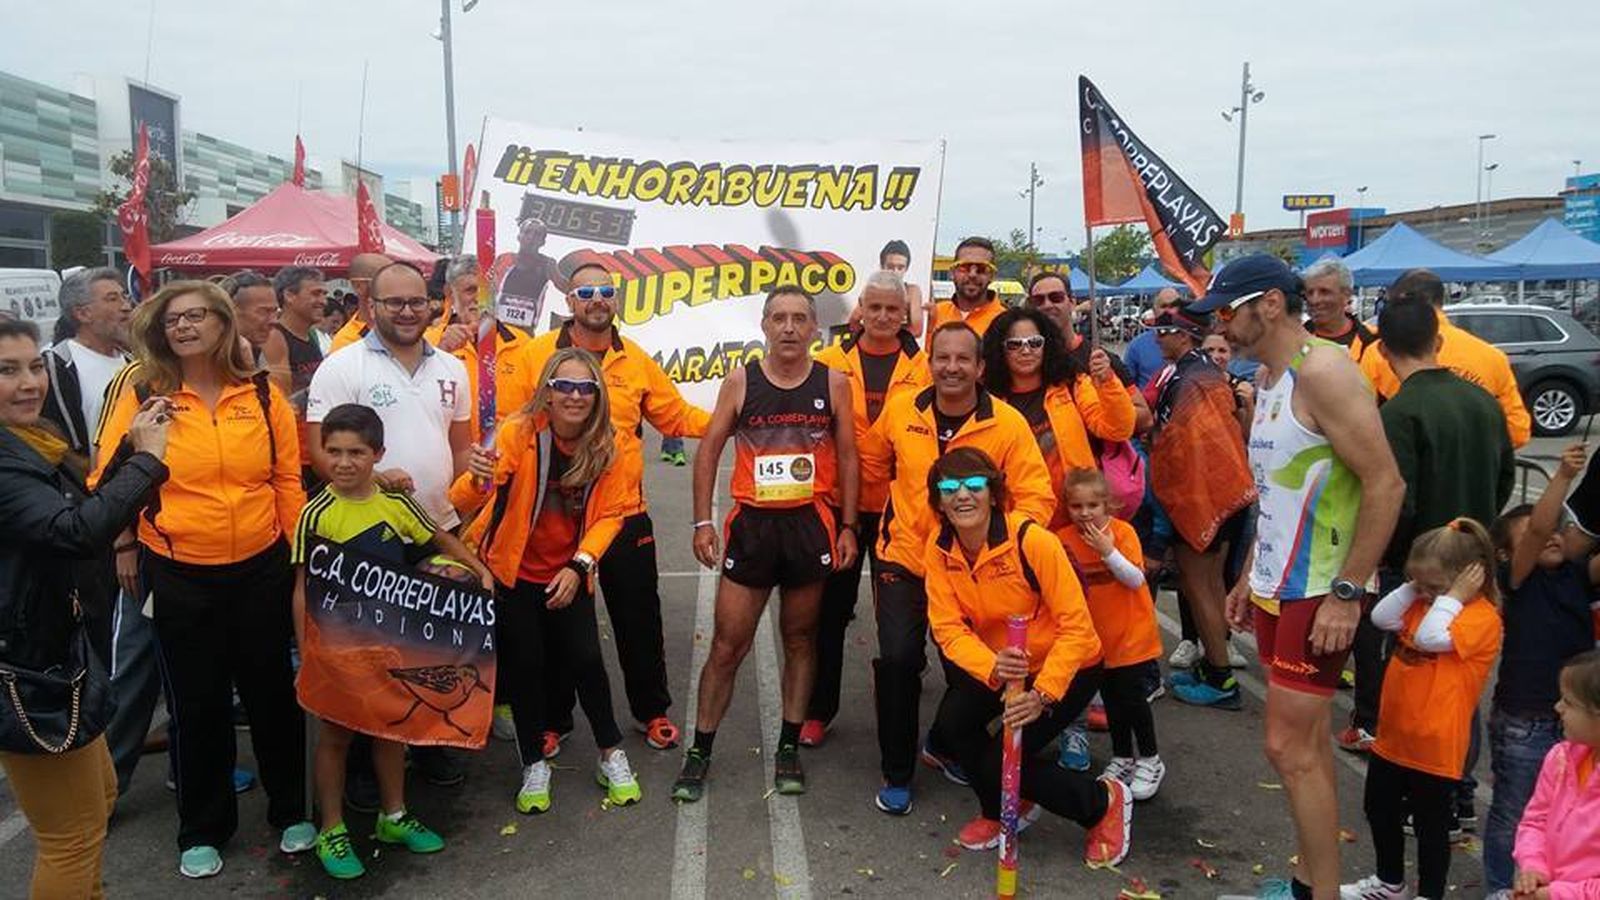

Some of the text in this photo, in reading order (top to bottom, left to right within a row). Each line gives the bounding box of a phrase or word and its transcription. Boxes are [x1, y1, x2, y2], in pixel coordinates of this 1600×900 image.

[1286, 196, 1332, 208] IKEA
[614, 252, 856, 326] UPERPACO
[504, 308, 528, 322] 1124
[759, 462, 784, 477] 145
[351, 561, 496, 626] CORREPLAYAS
